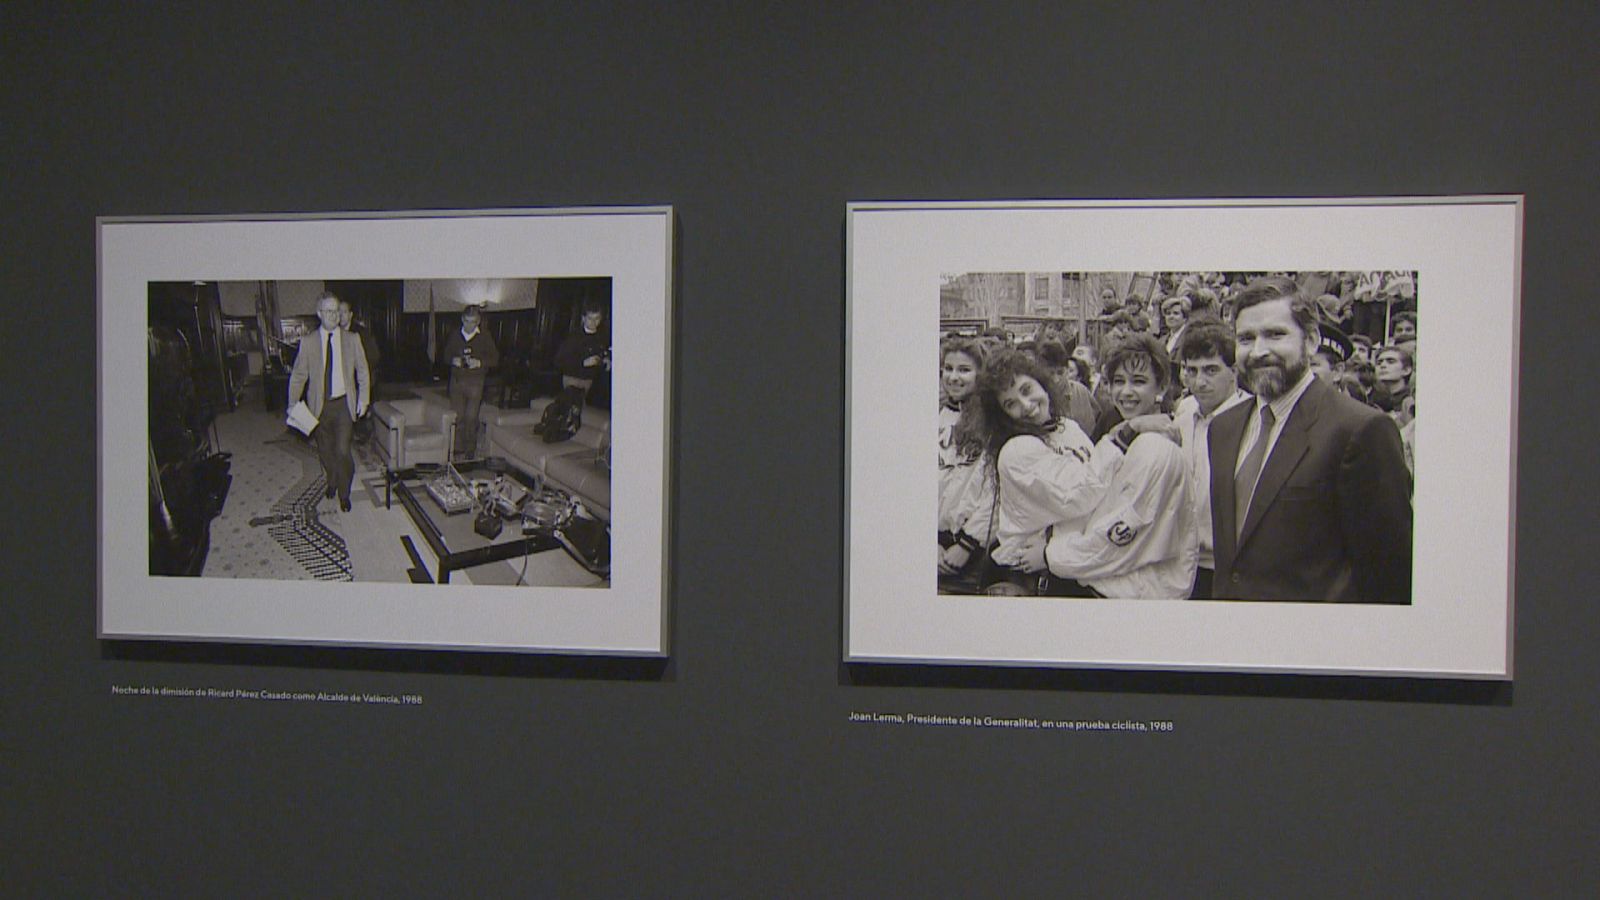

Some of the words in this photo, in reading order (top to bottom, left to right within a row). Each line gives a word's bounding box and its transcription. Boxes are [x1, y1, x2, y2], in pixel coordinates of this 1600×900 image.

[112, 685, 138, 694] Noche
[140, 687, 151, 695] de
[153, 687, 159, 695] la
[160, 688, 194, 696] dimisión
[208, 688, 234, 698] Ricard
[235, 689, 259, 698] Pérez
[260, 690, 291, 700] Casado
[292, 693, 316, 701] como
[317, 692, 349, 702] Alcalde
[350, 694, 361, 702] de
[362, 694, 400, 704] València,
[402, 695, 423, 705] 1988
[848, 711, 871, 721] Joan
[873, 712, 905, 724] Lerma,
[907, 713, 958, 725] Presidente
[959, 716, 972, 726] de
[973, 716, 982, 726] la
[984, 717, 1040, 728] Generalitat,
[1041, 720, 1054, 728] en
[1055, 721, 1074, 729] una
[1075, 720, 1110, 731] prueba
[1111, 720, 1148, 732] ciclista,
[1150, 722, 1174, 731] 1988
